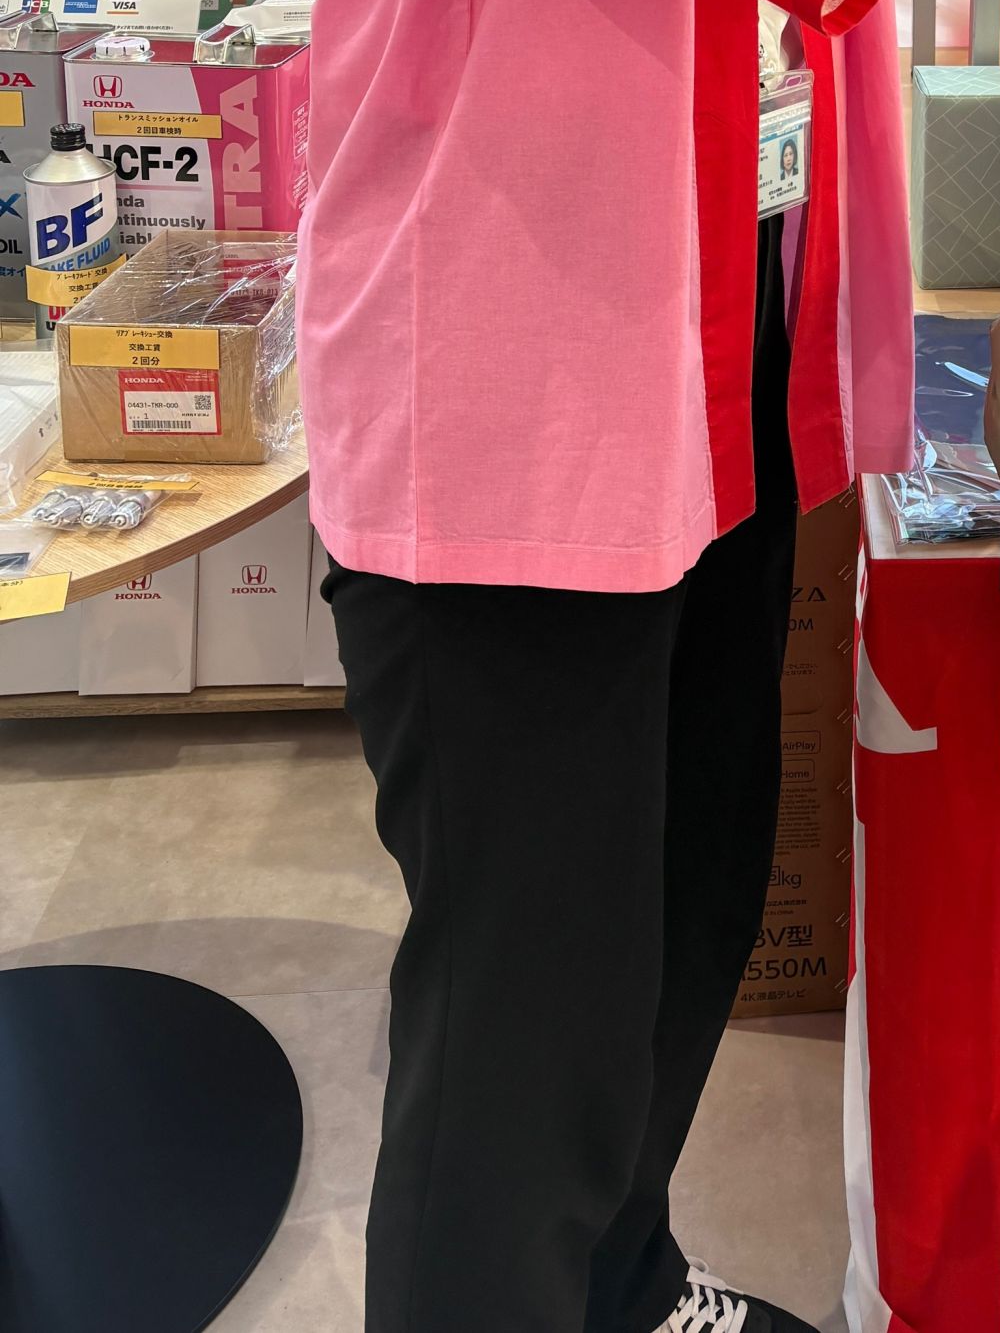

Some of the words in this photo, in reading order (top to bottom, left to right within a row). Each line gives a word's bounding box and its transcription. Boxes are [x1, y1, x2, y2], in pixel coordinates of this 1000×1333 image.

[113, 1, 137, 10] VISA
[83, 100, 135, 109] HONDA
[117, 114, 199, 123] トランスミッションオイル
[36, 193, 104, 260] BF
[77, 236, 111, 267] FLUID
[129, 344, 161, 352] 交換工賃
[132, 356, 161, 365] 2回分
[232, 586, 277, 595] HONDA
[115, 593, 162, 601] HONDA
[782, 741, 816, 752] AirPlay
[782, 869, 801, 889] kg
[742, 957, 827, 981] 550M
[740, 988, 807, 1003] 4K液晶テレビ
